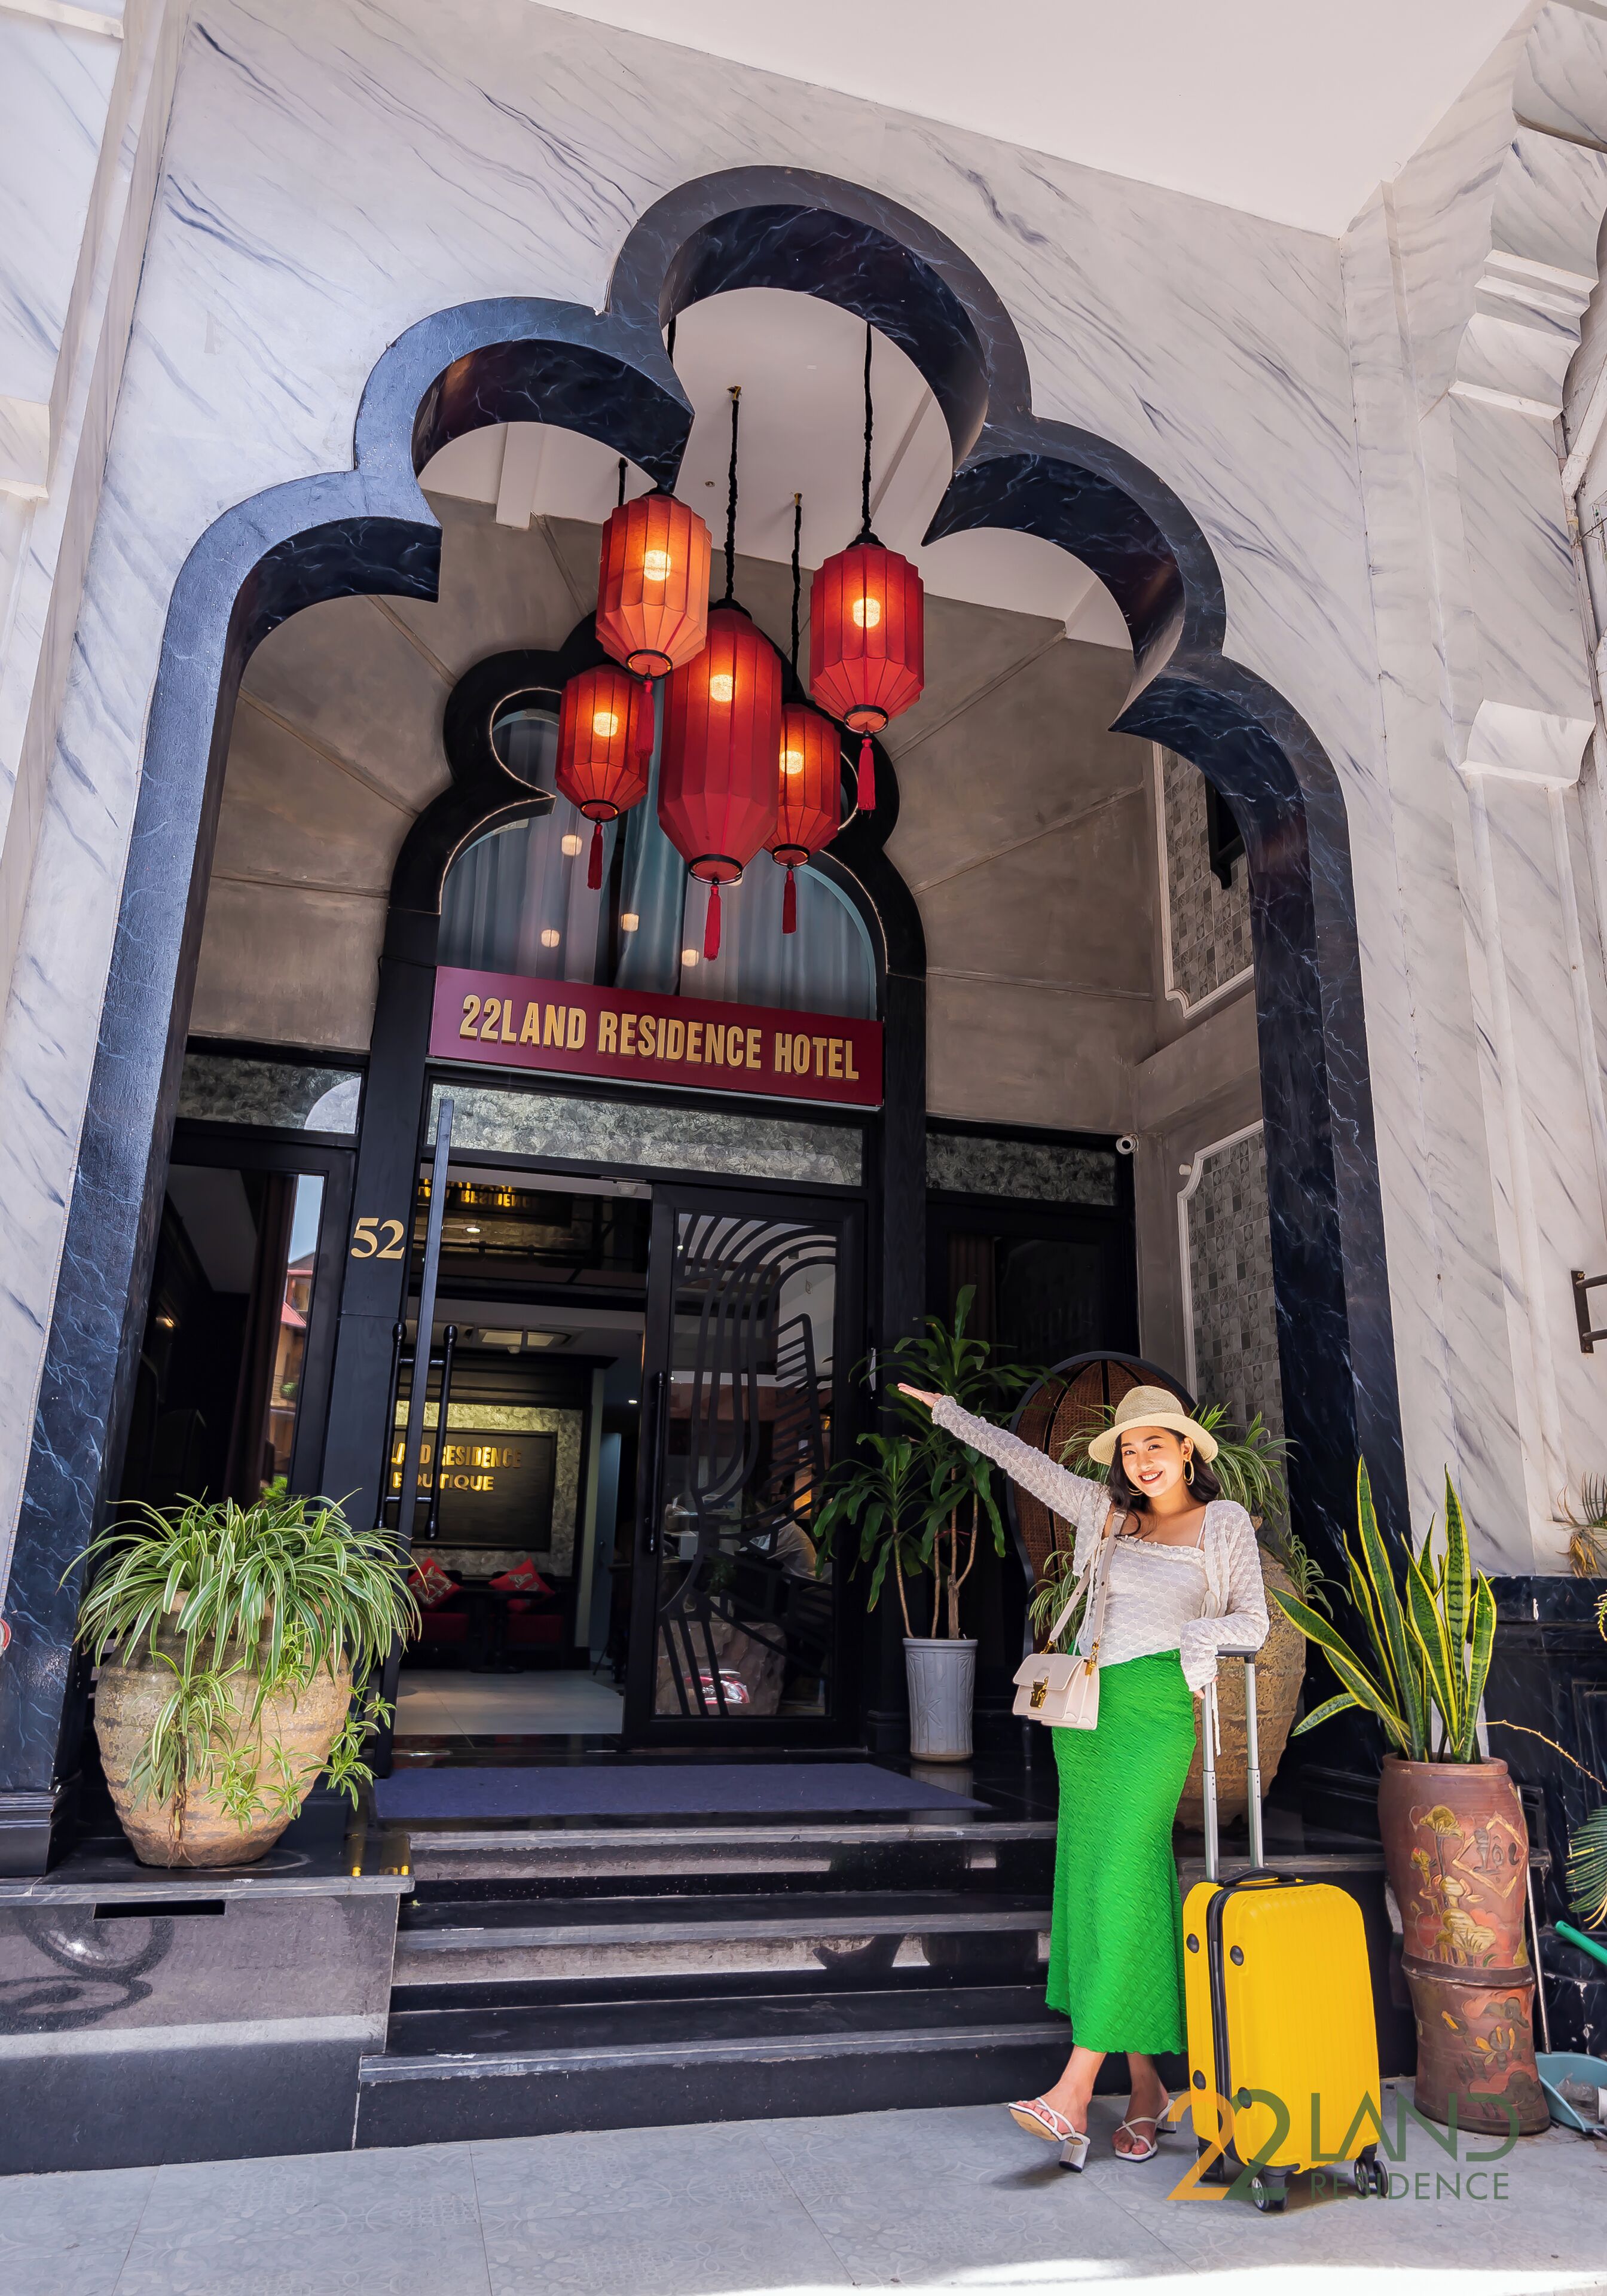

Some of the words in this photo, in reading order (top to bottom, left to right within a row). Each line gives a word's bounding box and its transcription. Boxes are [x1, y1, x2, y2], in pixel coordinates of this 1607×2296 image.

[459, 994, 586, 1049] 22LAND
[598, 1011, 762, 1068] RESIDENCE
[774, 1033, 859, 1080] HOTEL
[351, 1217, 405, 1259] 52
